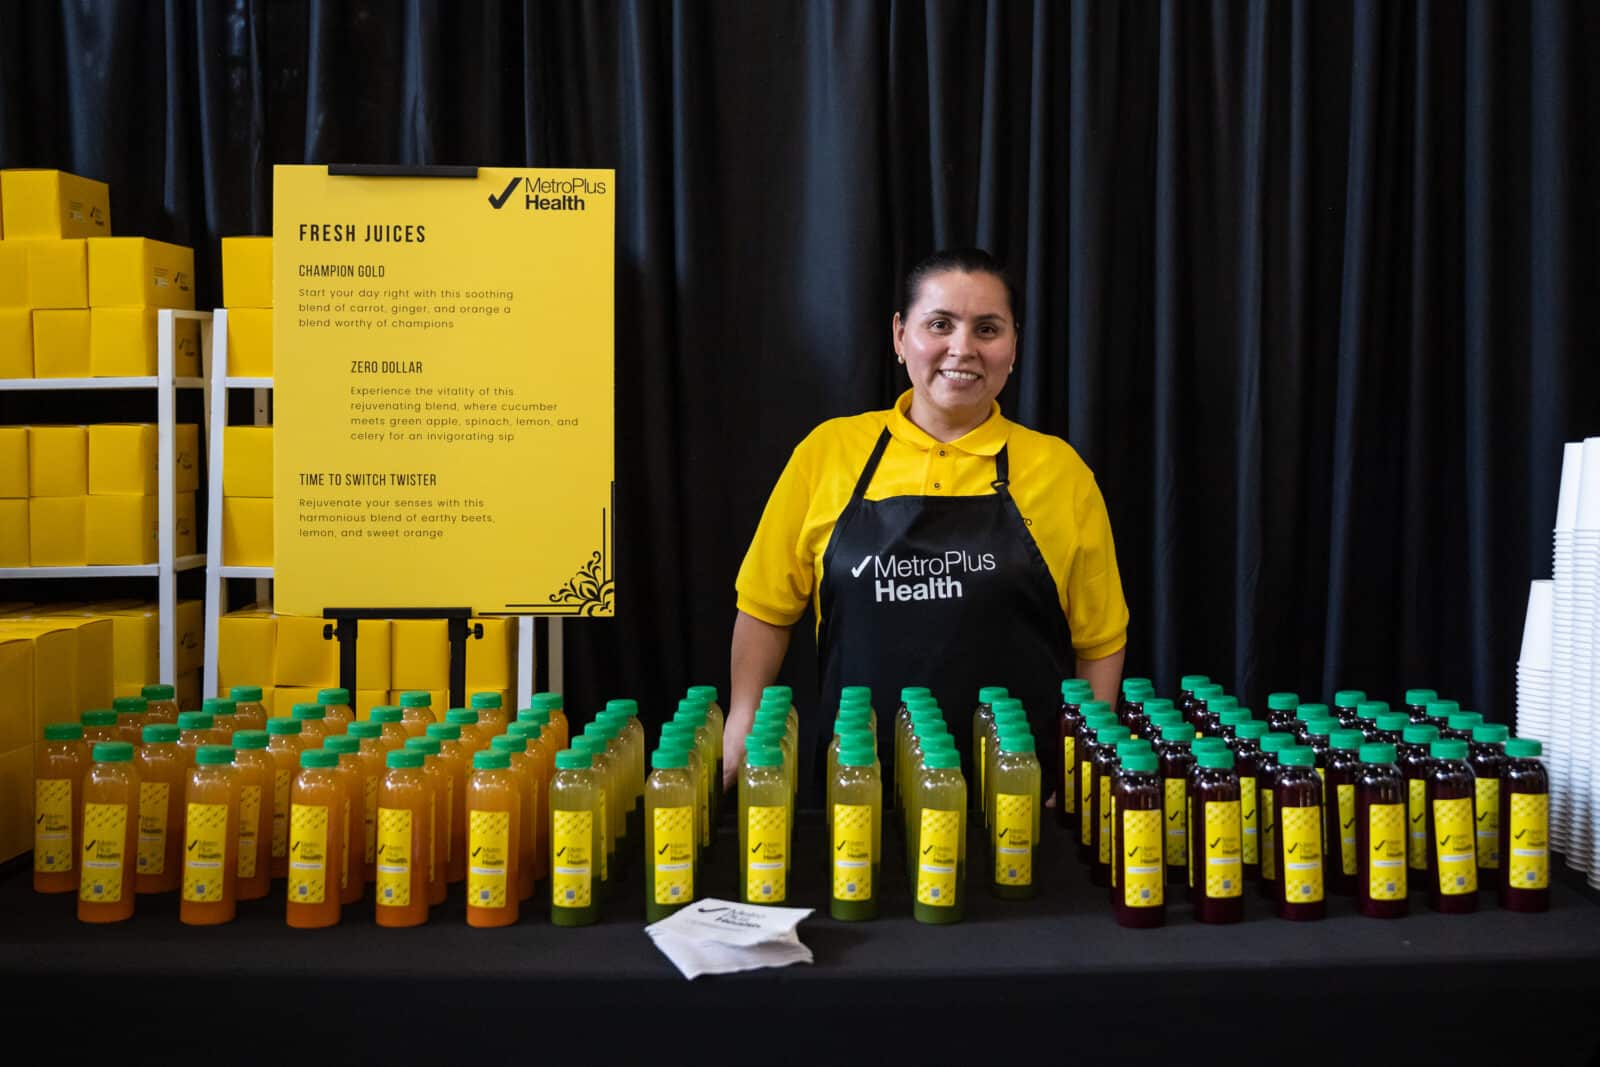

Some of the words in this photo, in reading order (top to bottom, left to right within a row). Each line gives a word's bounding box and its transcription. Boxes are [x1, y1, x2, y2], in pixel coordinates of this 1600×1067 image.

[525, 176, 607, 194] MetroPlus
[525, 194, 585, 211] Health
[299, 223, 356, 243] FRESH
[364, 224, 426, 243] JUICES
[298, 264, 355, 278] CHAMPION
[357, 264, 385, 278] GOLD
[298, 288, 326, 298] Start
[329, 289, 354, 300] your
[357, 287, 380, 300] day
[383, 288, 410, 300] right
[413, 288, 438, 299] with
[440, 289, 461, 299] this
[465, 289, 514, 301] soothing
[298, 303, 331, 313] blend
[334, 303, 346, 313] of
[433, 304, 456, 314] and
[459, 306, 500, 317] orange
[503, 306, 512, 314] a
[298, 318, 331, 328] blend
[334, 318, 373, 330] worthy
[376, 319, 388, 328] of
[391, 319, 455, 331] champions
[350, 360, 379, 374] ZERO
[381, 360, 423, 374] DOLLAR
[350, 386, 412, 398] Experience
[415, 387, 433, 396] the
[437, 386, 475, 397] vitality
[478, 386, 490, 397] of
[493, 386, 514, 397] this
[350, 401, 422, 414] rejuvenating
[424, 401, 460, 412] blend,
[463, 401, 498, 411] where
[501, 402, 558, 412] cucumber
[350, 417, 386, 426] meets
[389, 417, 422, 428] green
[556, 417, 580, 427] and
[350, 431, 385, 443] celery
[388, 431, 405, 441] for
[408, 432, 423, 441] an
[426, 431, 495, 444] invigorating
[498, 431, 515, 444] sip
[298, 472, 325, 487] TIME
[327, 472, 342, 487] TO
[344, 472, 387, 487] SWITCH
[389, 472, 437, 487] TWISTER
[298, 498, 362, 510] Rejuvenate
[365, 499, 390, 509] your
[394, 499, 433, 508] senses
[436, 498, 461, 508] with
[463, 497, 485, 508] this
[299, 513, 367, 523] harmonious
[370, 512, 402, 523] blend
[405, 513, 417, 523] of
[420, 513, 457, 525] earthy
[460, 513, 496, 524] beets,
[299, 527, 337, 539] lemon,
[340, 528, 363, 537] and
[366, 528, 399, 538] sweet
[403, 529, 444, 540] orange
[874, 550, 997, 578] MetroPlus
[874, 575, 963, 603] Health
